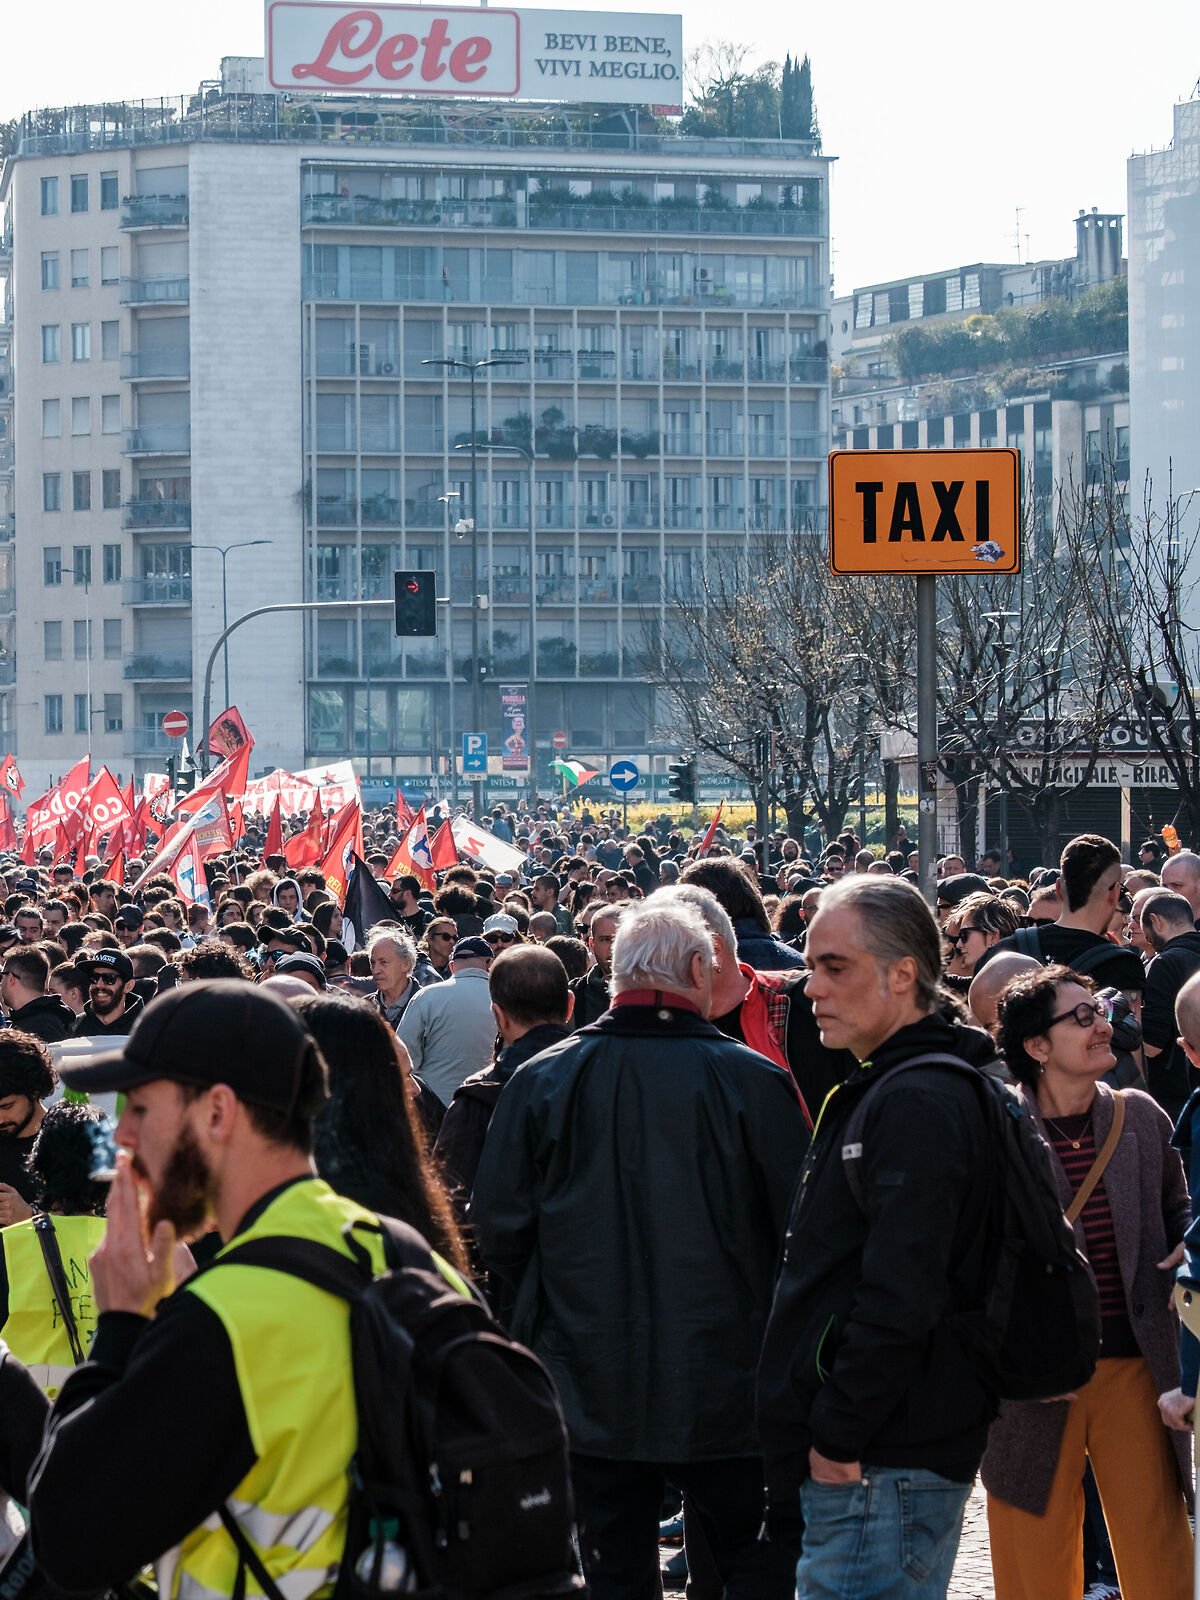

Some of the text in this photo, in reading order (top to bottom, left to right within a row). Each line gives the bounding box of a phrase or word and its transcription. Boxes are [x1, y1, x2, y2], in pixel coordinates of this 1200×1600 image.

[292, 10, 492, 84] Lete
[545, 33, 672, 58] BEVI BENE,
[535, 58, 680, 81] VIVI MEGLIO.
[855, 480, 989, 543] TAXI
[468, 736, 482, 755] P
